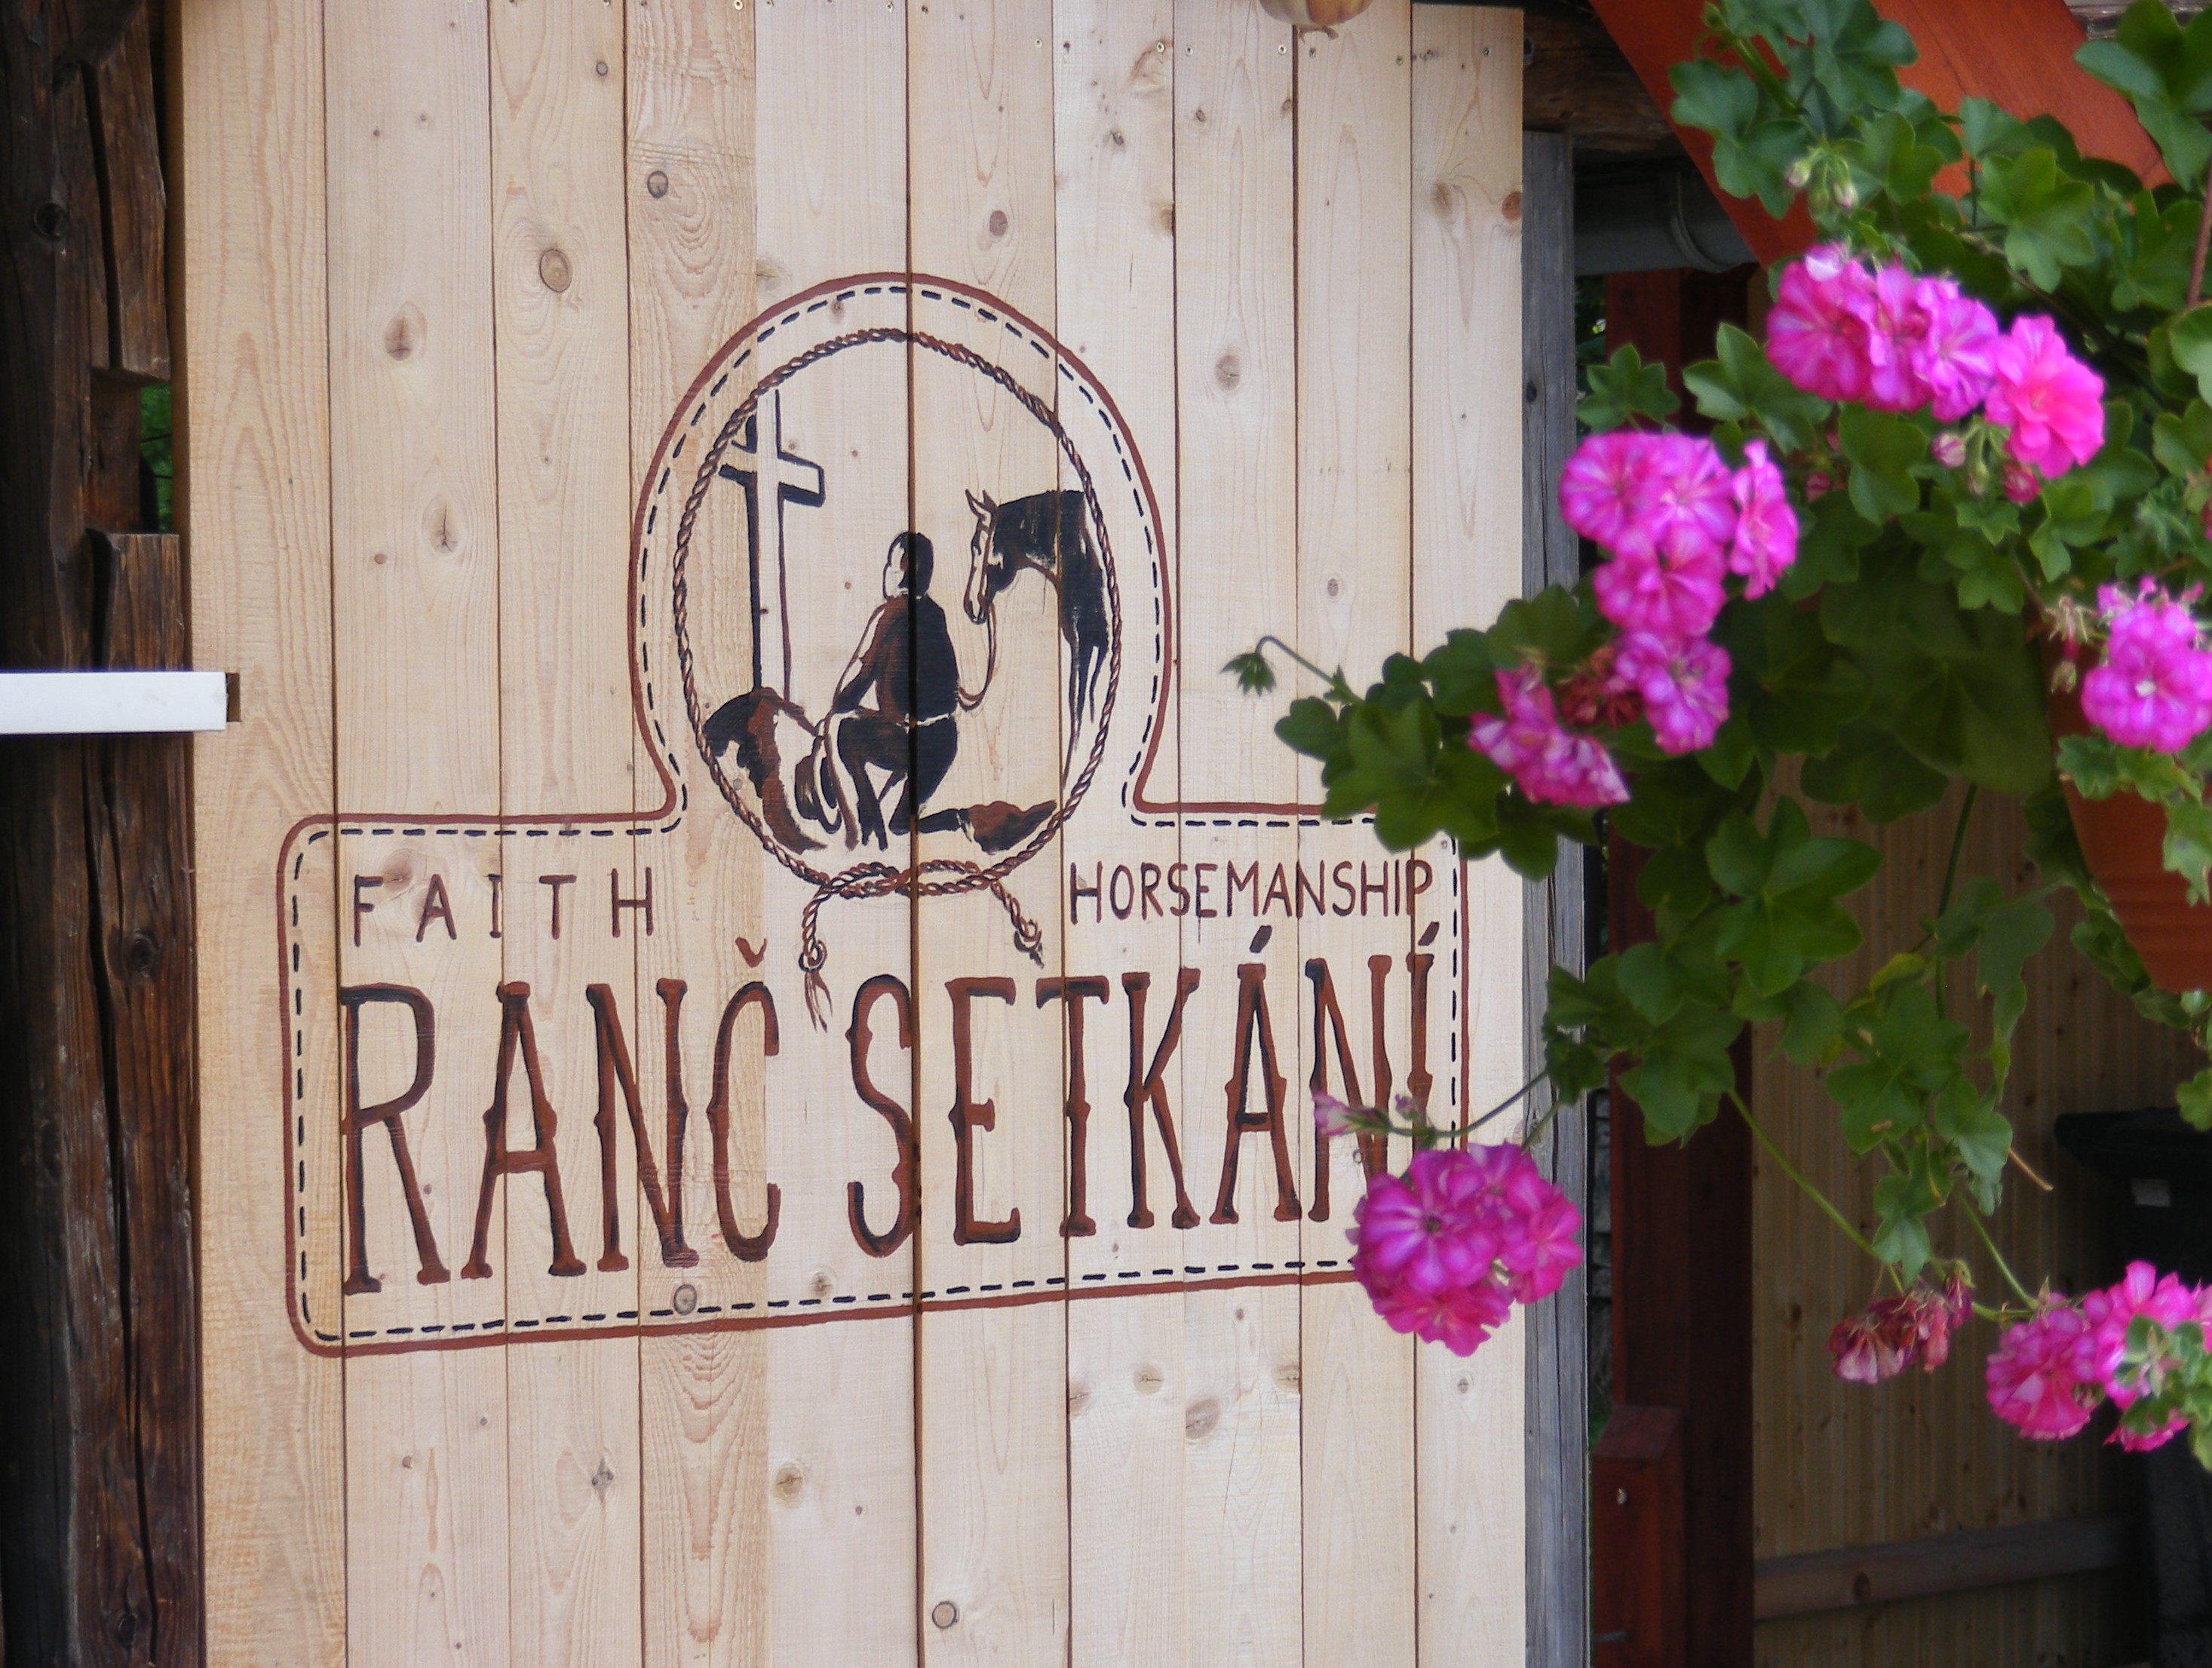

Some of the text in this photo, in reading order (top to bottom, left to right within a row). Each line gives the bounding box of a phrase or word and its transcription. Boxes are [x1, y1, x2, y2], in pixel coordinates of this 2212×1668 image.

[354, 859, 1433, 947] FAITH HORSEMANSHIP
[341, 936, 781, 1295] RANČ
